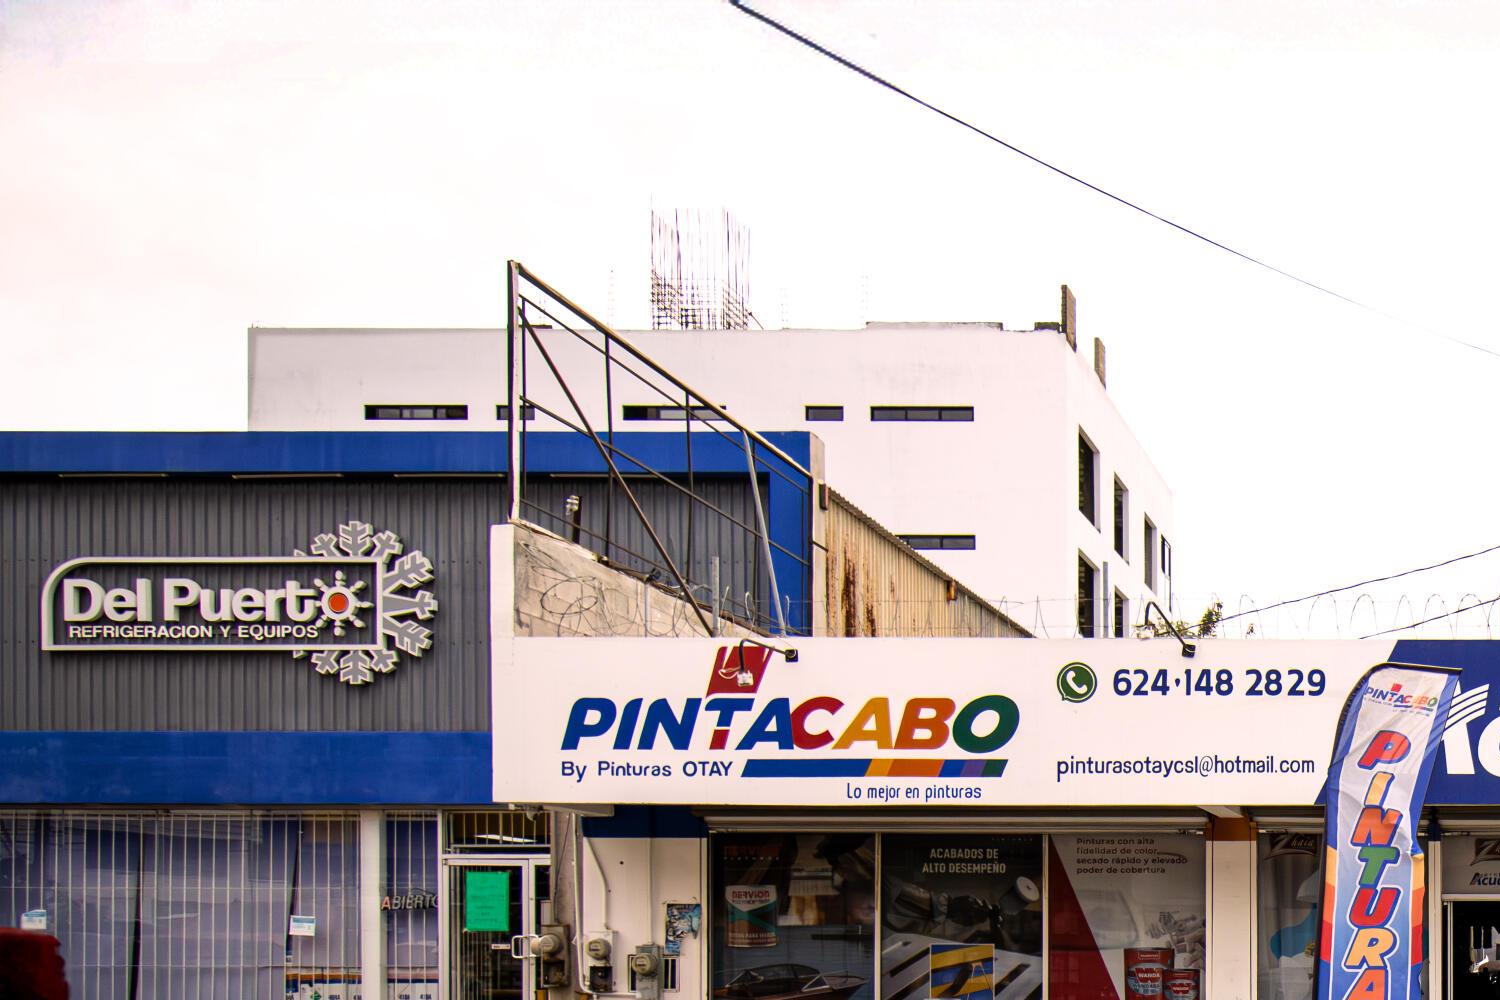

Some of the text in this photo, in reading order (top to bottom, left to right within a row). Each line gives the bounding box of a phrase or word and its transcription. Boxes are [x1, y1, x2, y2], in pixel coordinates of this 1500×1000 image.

[63, 578, 152, 621] Del
[69, 626, 319, 641] REFRIGERACION Y EQUIPOS
[1245, 668, 1327, 697] 2829
[560, 693, 1021, 755] PINTACABO
[562, 760, 733, 781] By Pinturas OTAY
[1057, 754, 1315, 782] pinturasotaycsl@hotmail.com
[847, 782, 982, 802] Lo mejor en pinturas
[929, 848, 999, 859] ACABADOS DE
[922, 861, 1007, 874] ALTO DESEMPEÑO
